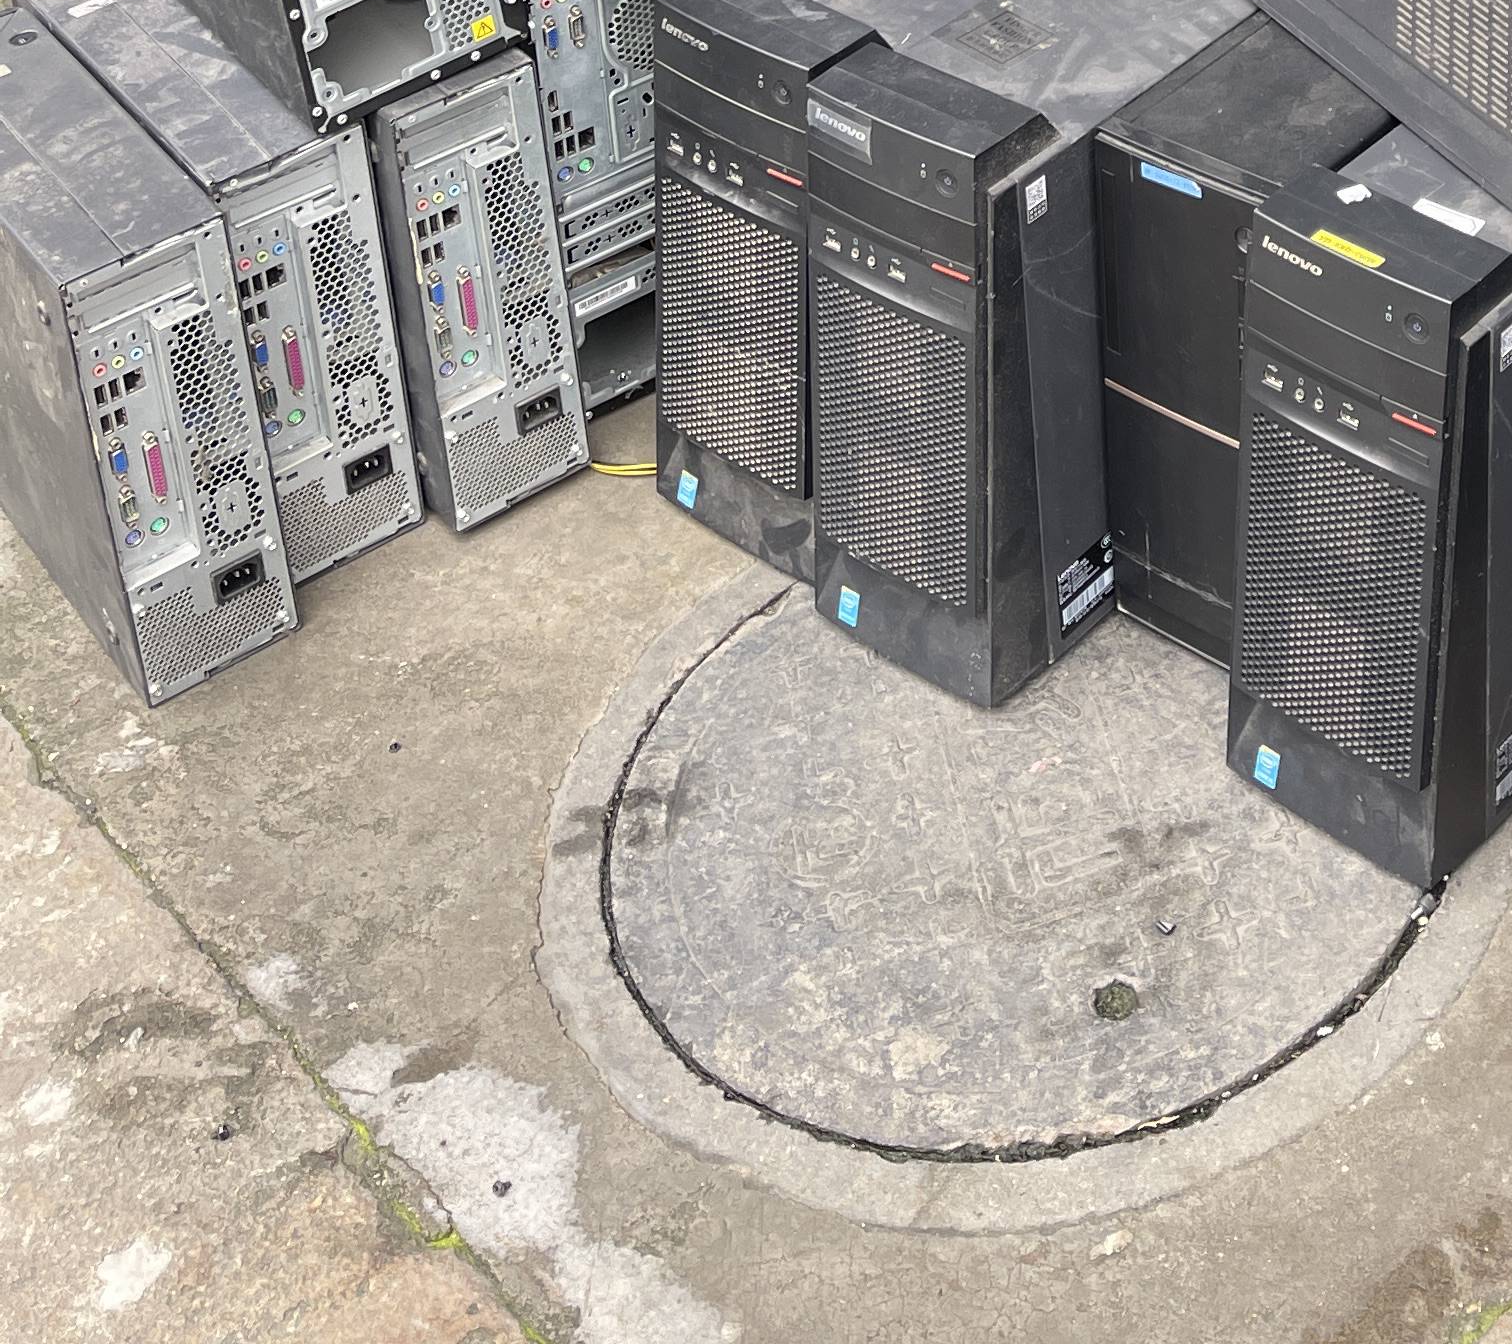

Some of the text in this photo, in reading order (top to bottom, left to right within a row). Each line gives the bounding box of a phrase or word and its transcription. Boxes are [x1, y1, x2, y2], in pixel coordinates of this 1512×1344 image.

[661, 18, 709, 51] lenovo
[815, 108, 866, 142] lenovo
[1262, 235, 1323, 276] lenovo
